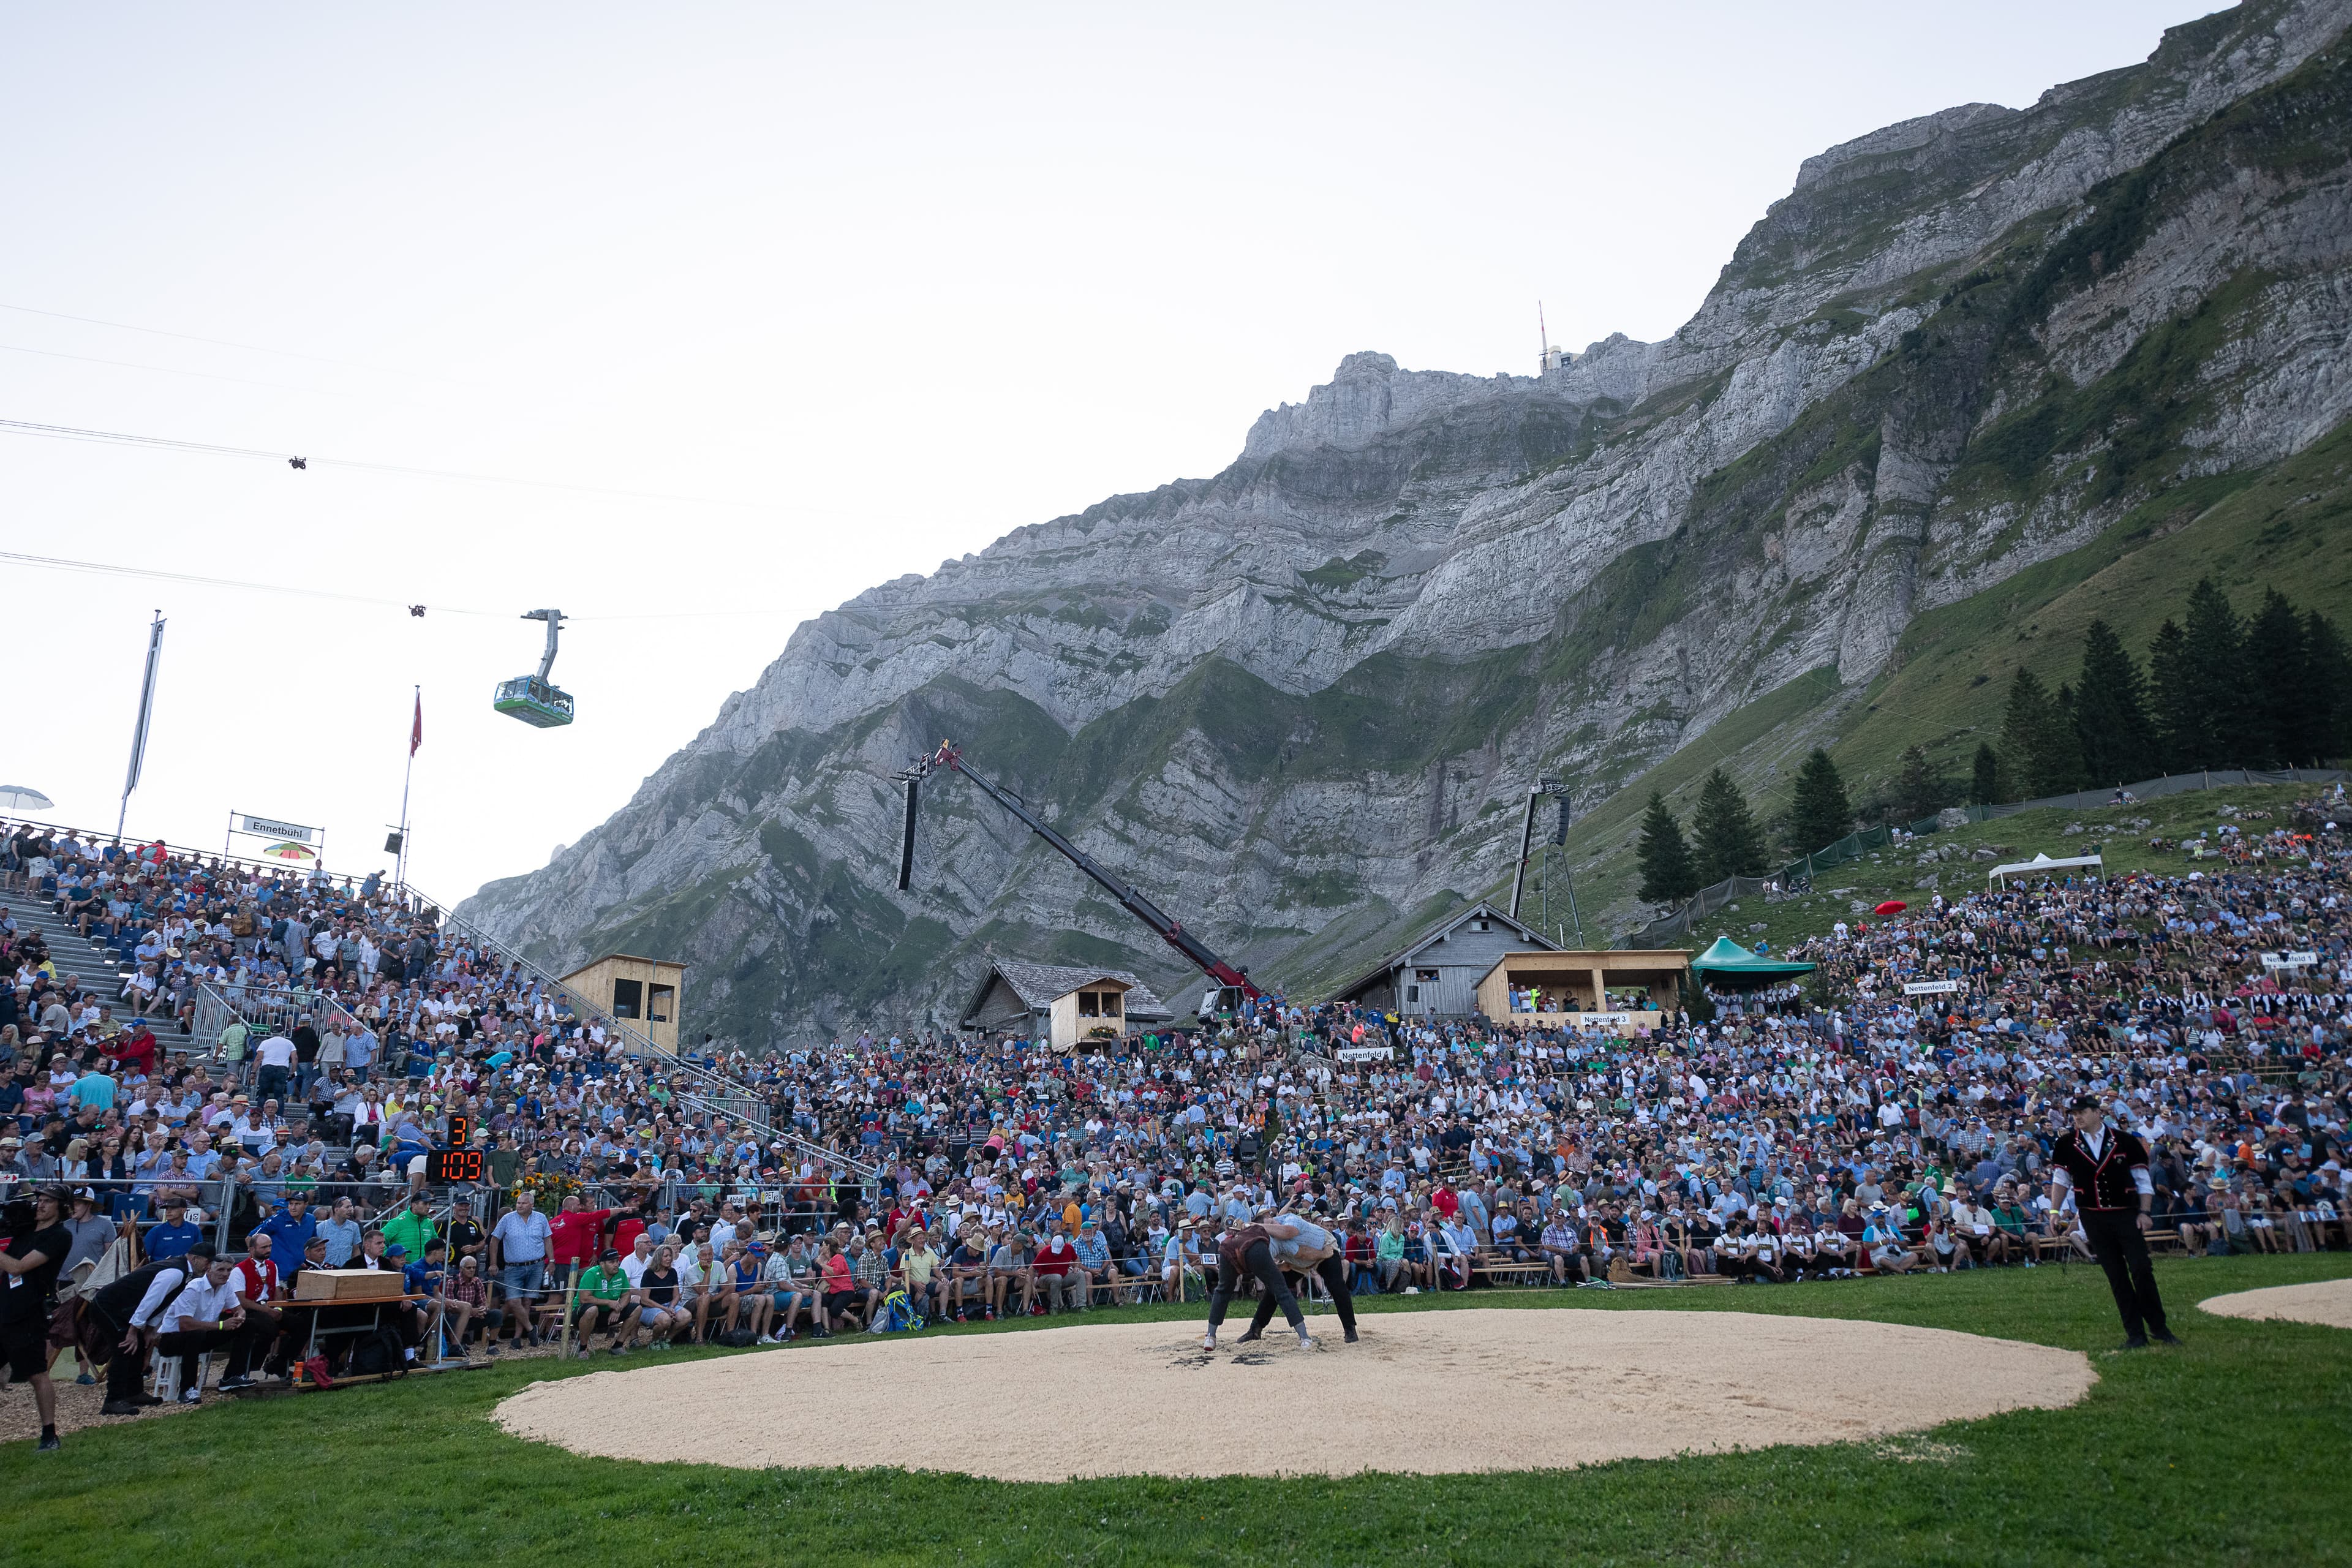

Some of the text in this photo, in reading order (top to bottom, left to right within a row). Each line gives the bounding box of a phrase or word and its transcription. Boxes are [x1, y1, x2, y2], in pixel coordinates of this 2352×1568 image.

[253, 822, 302, 838] Ennetbühl
[1343, 1051, 1382, 1060] Nettenfeld
[453, 1118, 466, 1145] 3
[442, 1152, 481, 1179] 109
